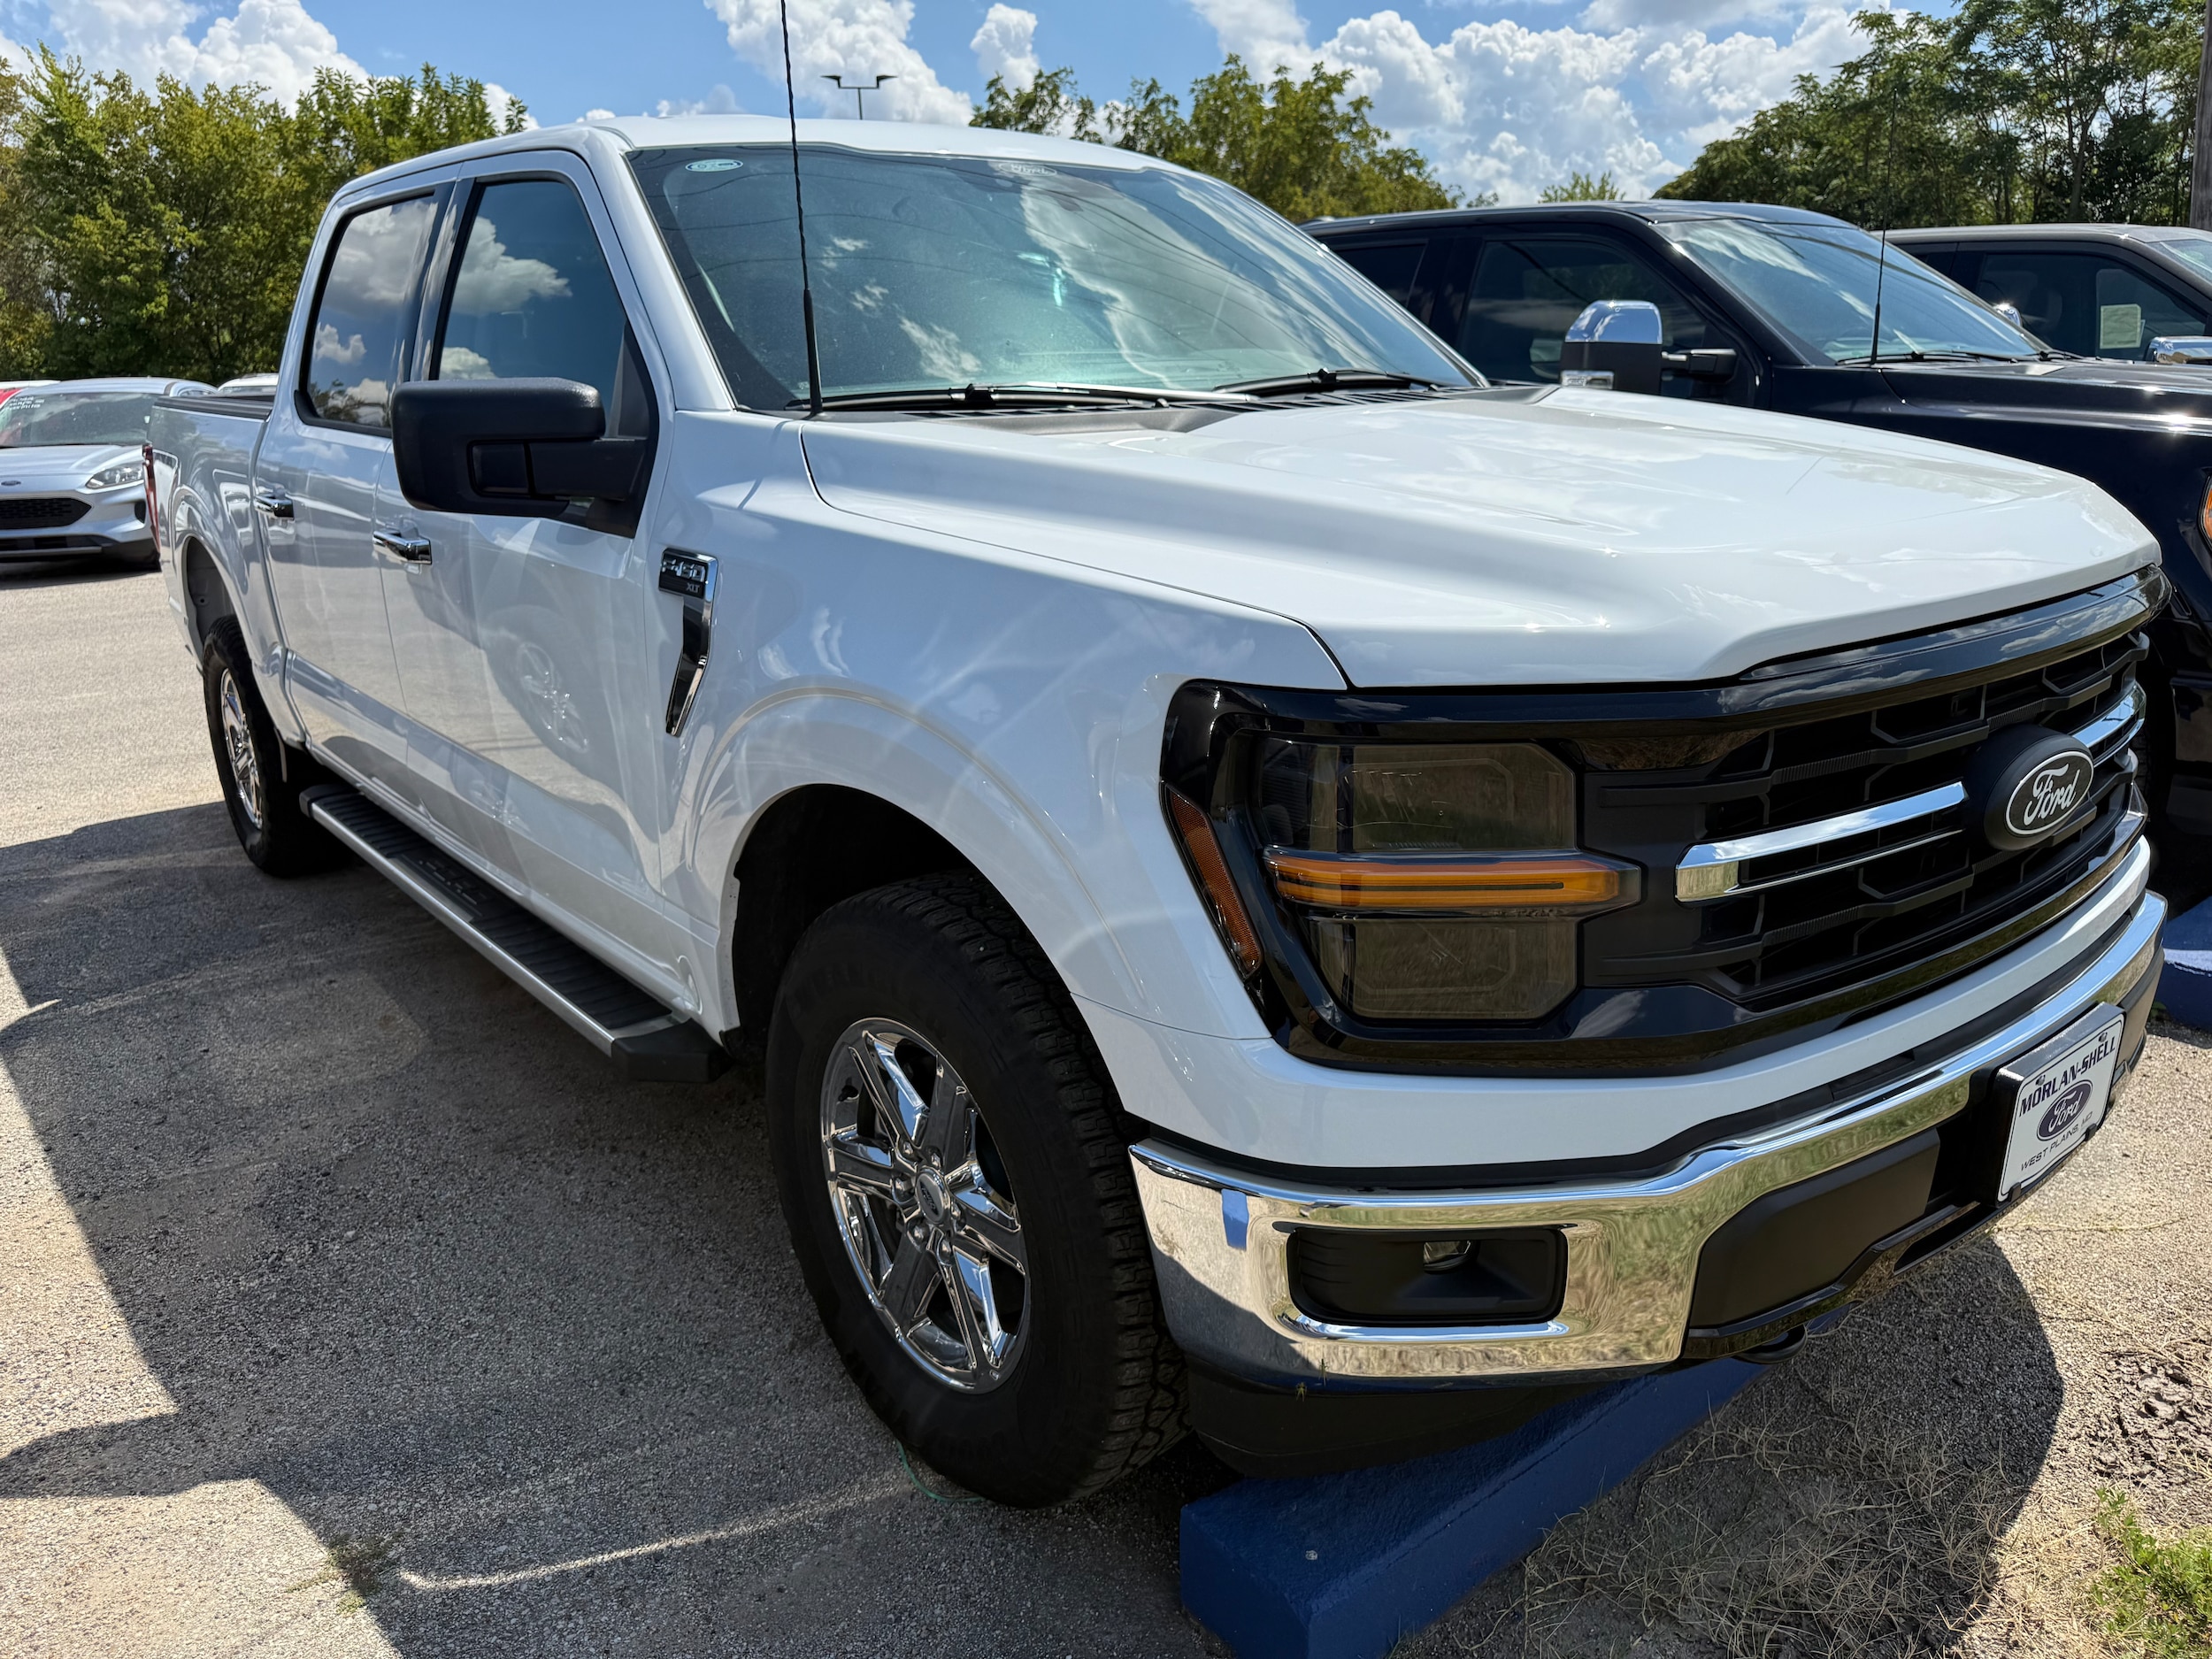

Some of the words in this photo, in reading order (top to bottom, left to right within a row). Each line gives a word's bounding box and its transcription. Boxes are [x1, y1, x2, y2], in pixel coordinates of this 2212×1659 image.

[686, 583, 700, 593] XLT
[2023, 763, 2080, 826] Ford
[2019, 1036, 2116, 1117] MORLAN-SHELL
[2048, 1090, 2083, 1133] Ford
[2021, 1148, 2048, 1171] WEST
